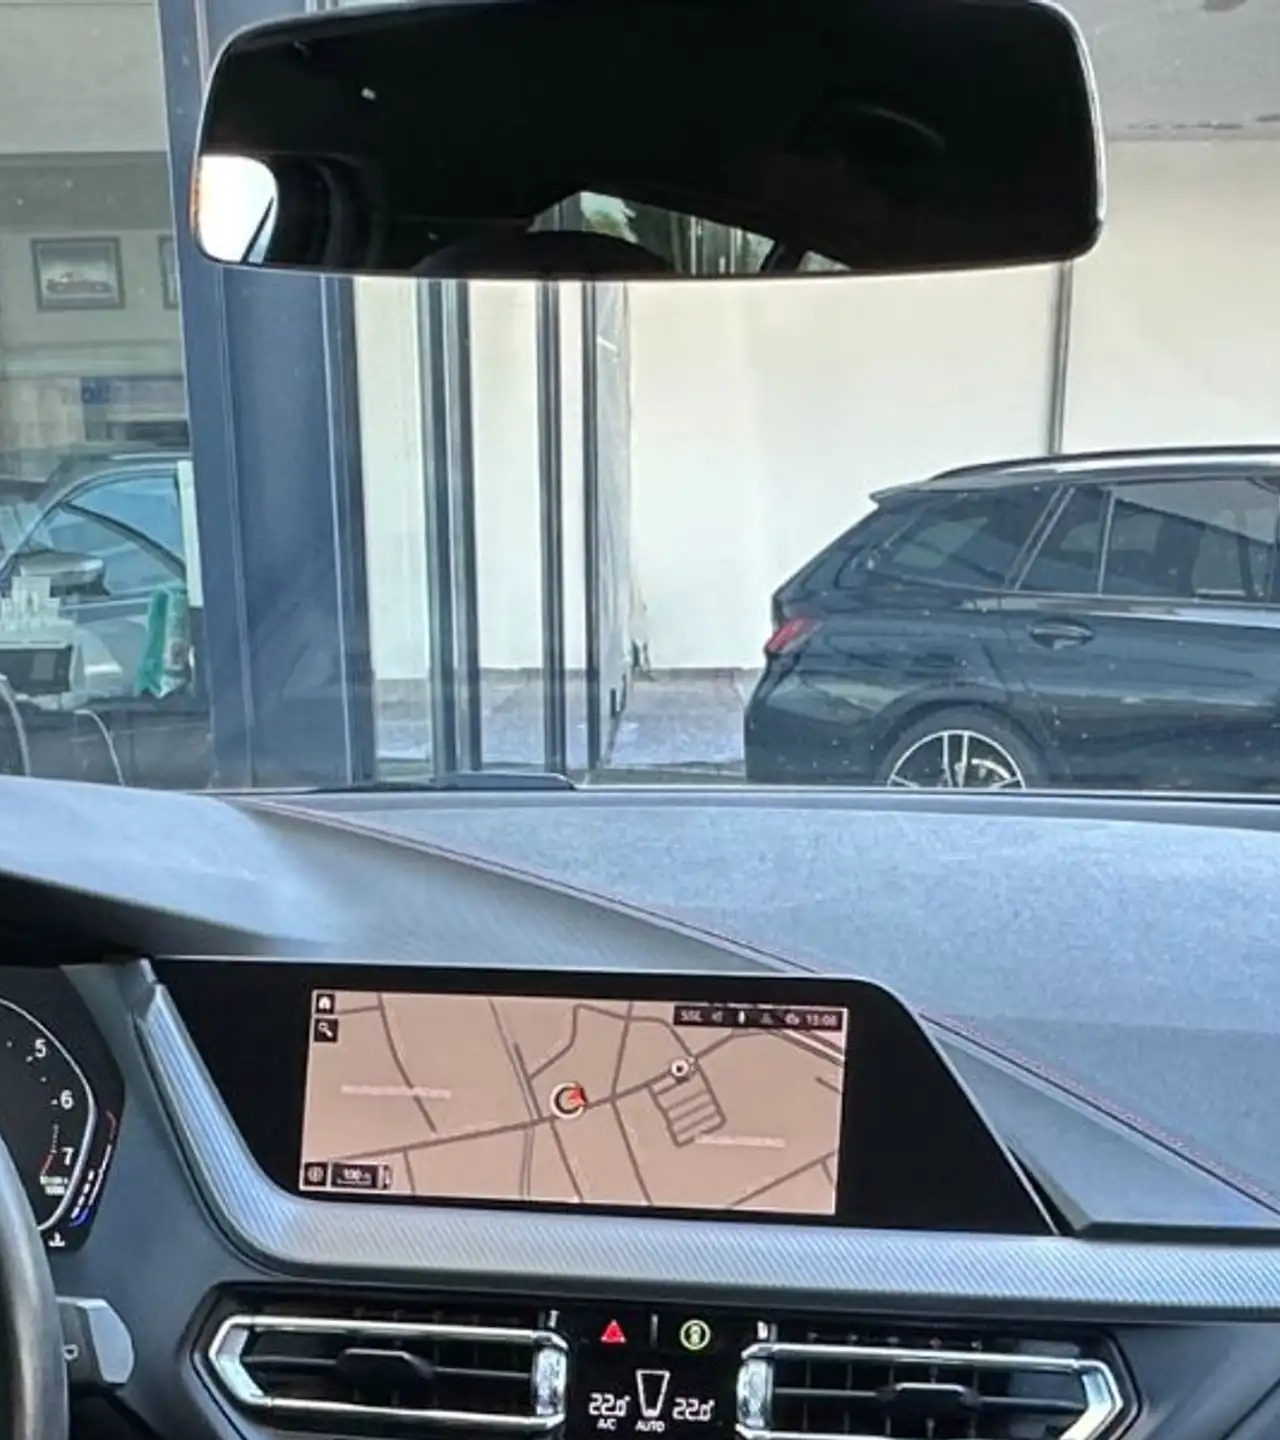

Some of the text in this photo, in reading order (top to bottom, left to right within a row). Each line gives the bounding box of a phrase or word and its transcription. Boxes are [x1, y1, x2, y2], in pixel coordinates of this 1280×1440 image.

[35, 1040, 47, 1057] 5
[60, 1089, 74, 1109] 6
[62, 1147, 75, 1165] 7
[597, 1418, 617, 1430] A/C
[635, 1420, 665, 1433] AUTO
